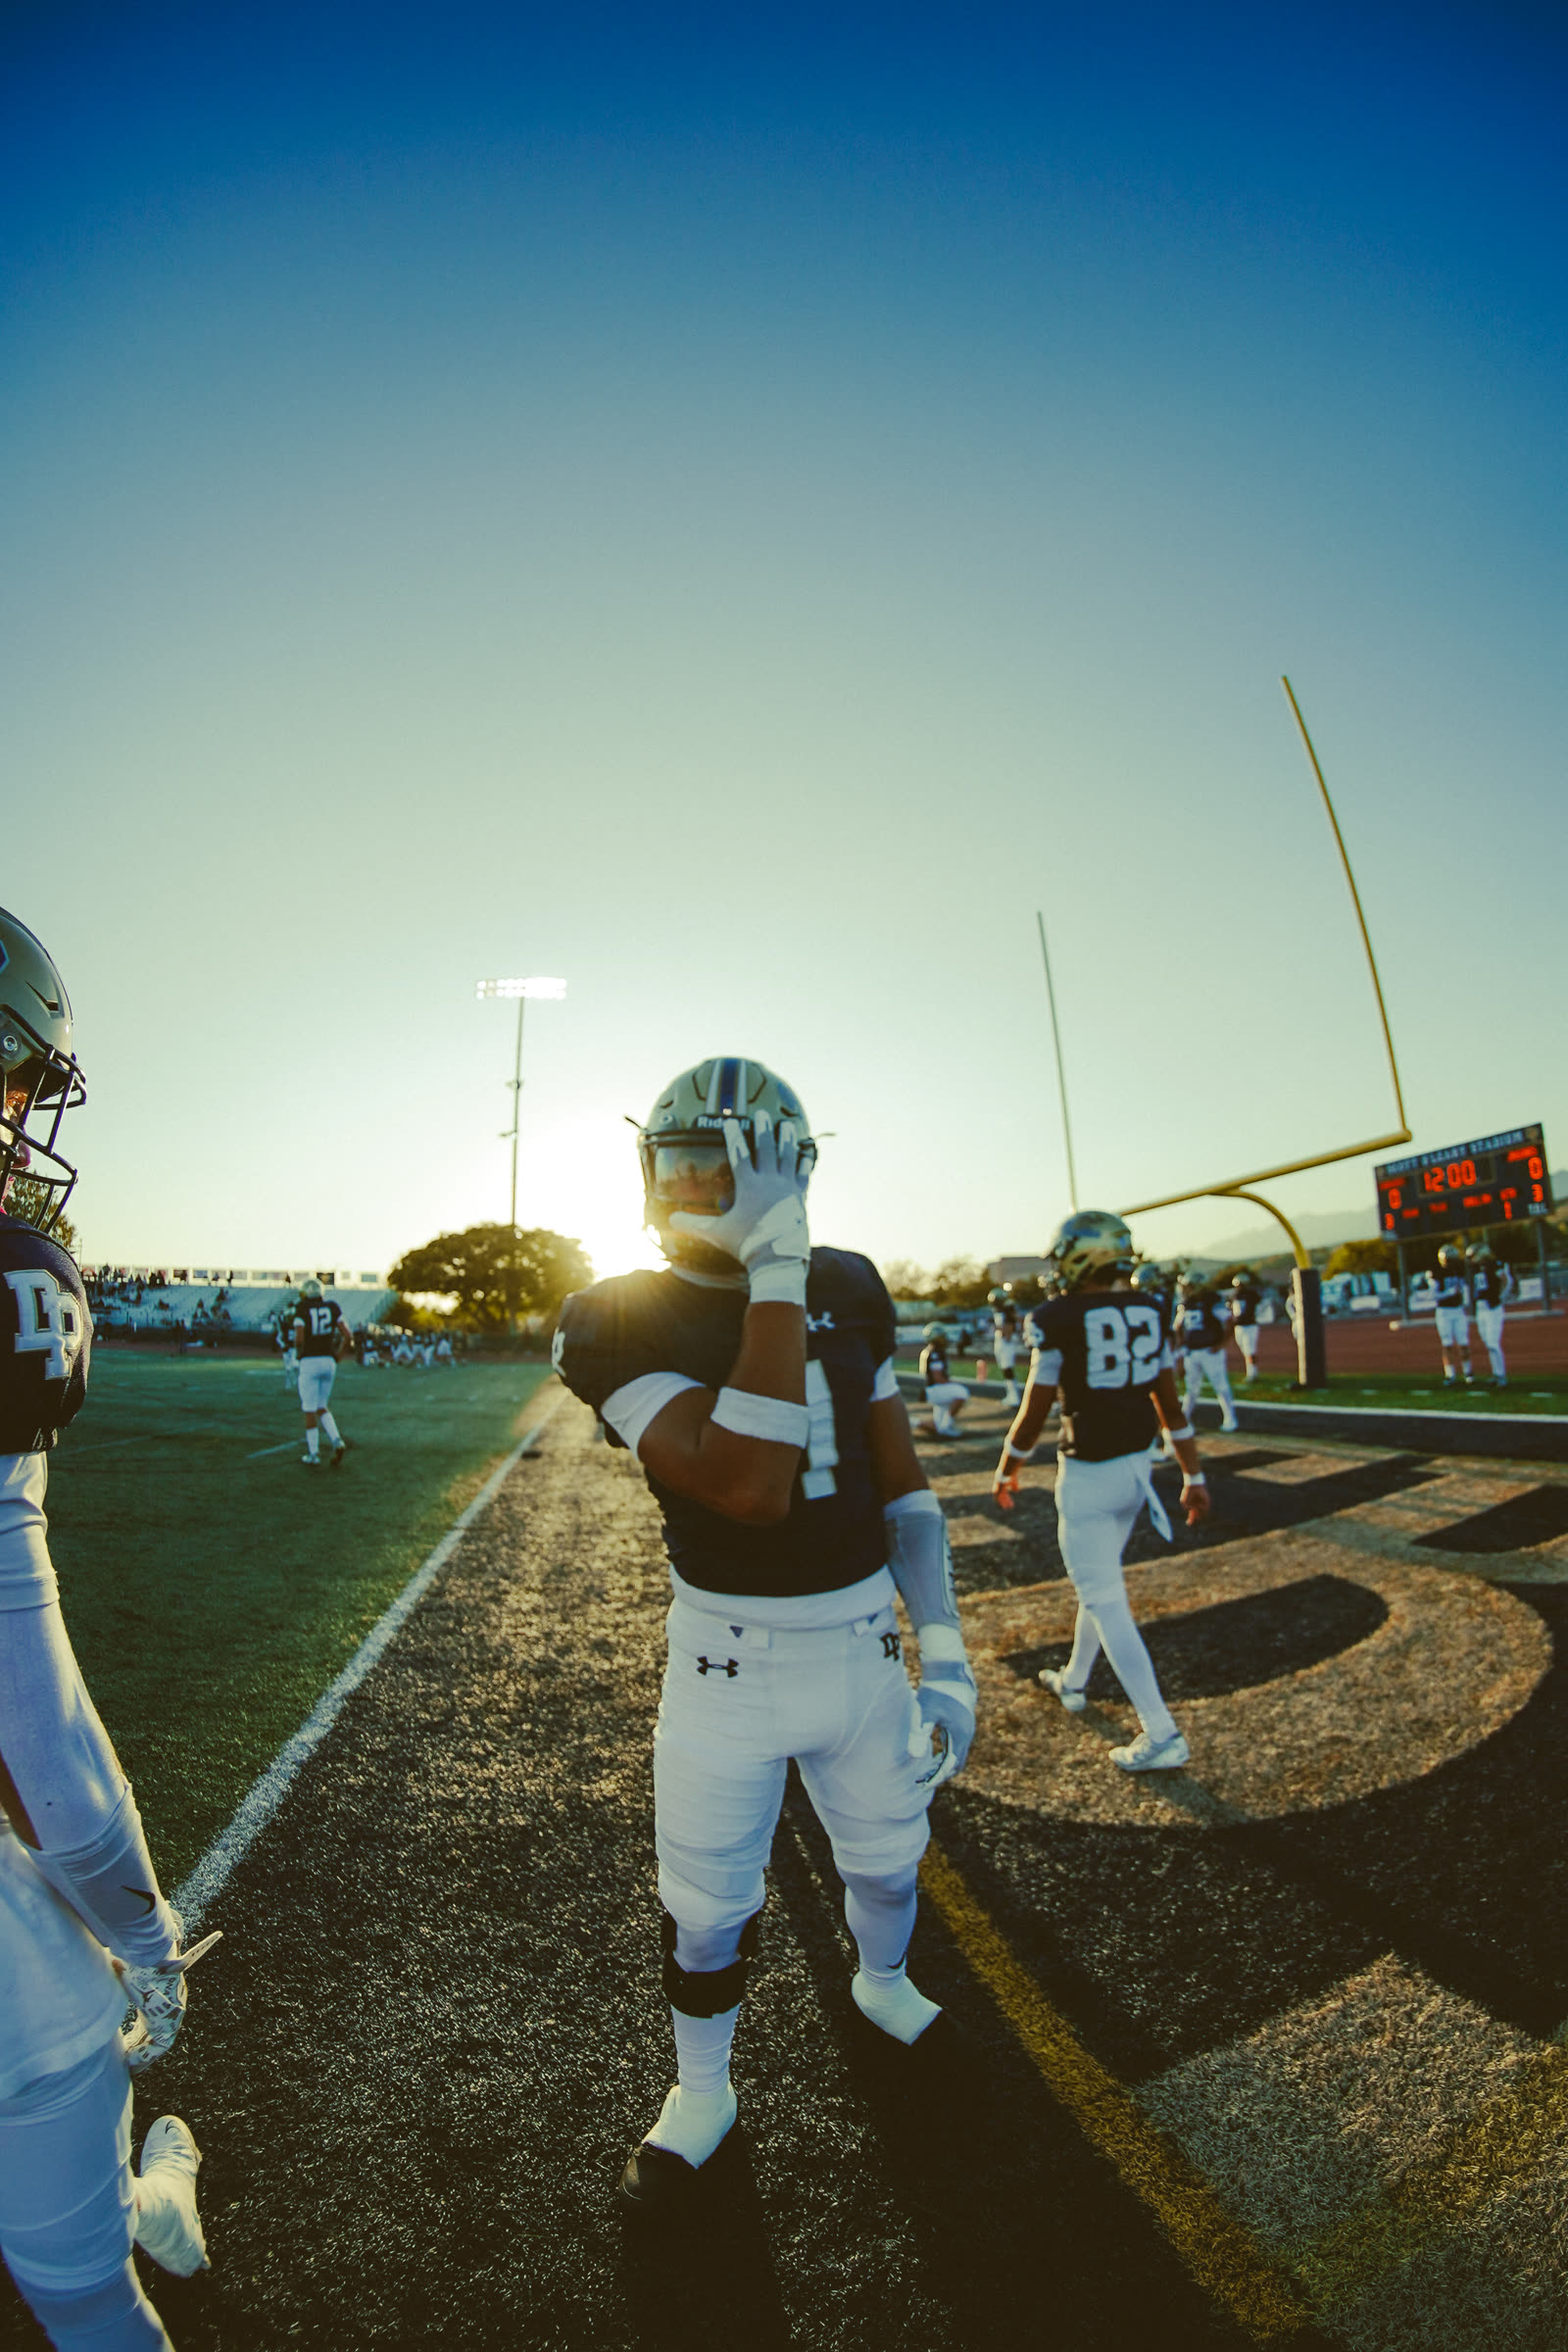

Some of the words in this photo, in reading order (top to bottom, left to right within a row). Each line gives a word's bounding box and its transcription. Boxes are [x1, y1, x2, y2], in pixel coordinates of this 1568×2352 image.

[698, 1116, 751, 1129] Ridll
[1528, 1156, 1544, 1180] 0
[309, 1306, 333, 1335] 12
[1084, 1305, 1161, 1390] 82
